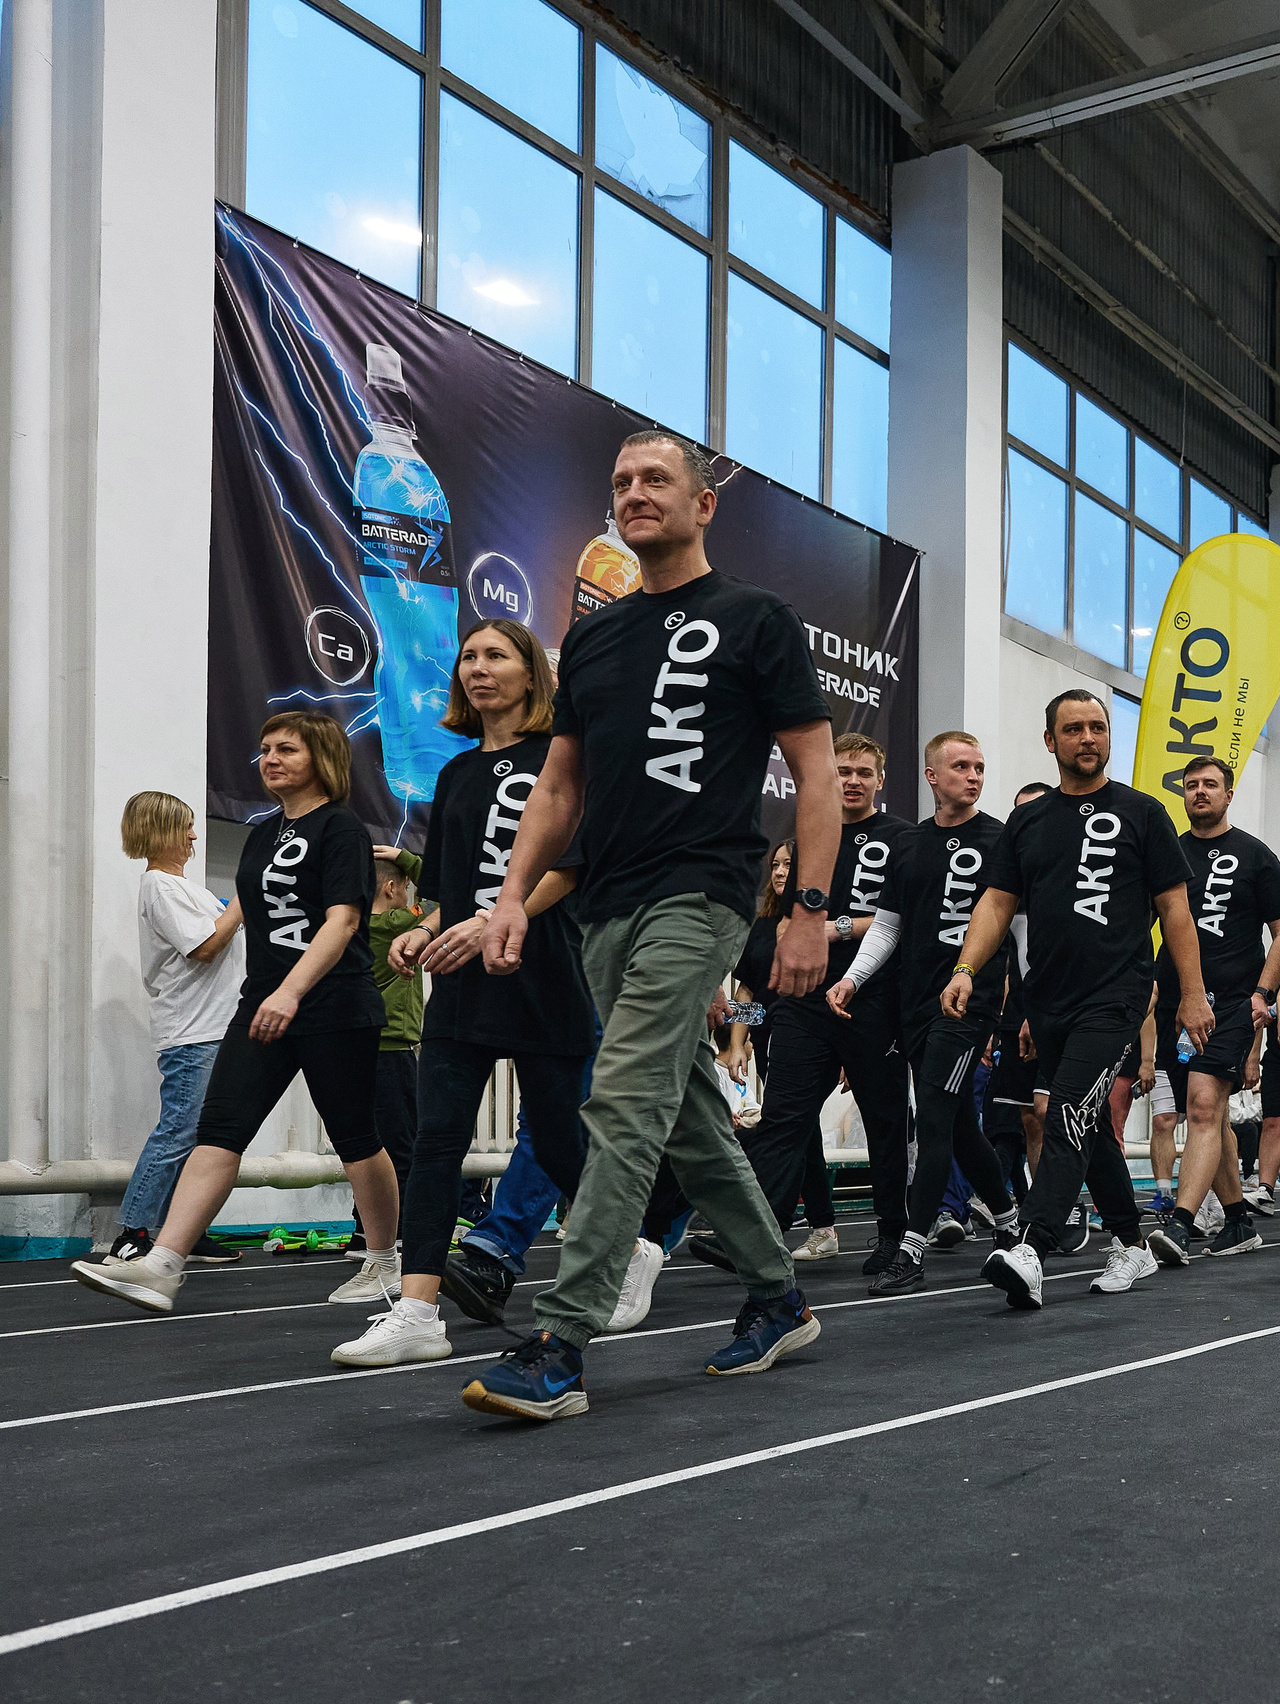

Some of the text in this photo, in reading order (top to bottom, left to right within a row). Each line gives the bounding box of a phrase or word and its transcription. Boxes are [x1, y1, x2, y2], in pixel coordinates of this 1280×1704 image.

[362, 524, 437, 547] BATTERADE
[363, 541, 416, 555] ARCTIC STORM
[483, 578, 519, 613] Mg
[317, 633, 353, 662] Ca
[803, 622, 900, 681] ТОНИК
[645, 619, 720, 793] АКТО
[1228, 677, 1250, 770] если не мы
[261, 837, 309, 951] АКТО
[850, 841, 890, 913] КТО
[938, 848, 982, 946] АКТО
[1074, 812, 1121, 926] АКТО
[1198, 854, 1239, 938] АКТО
